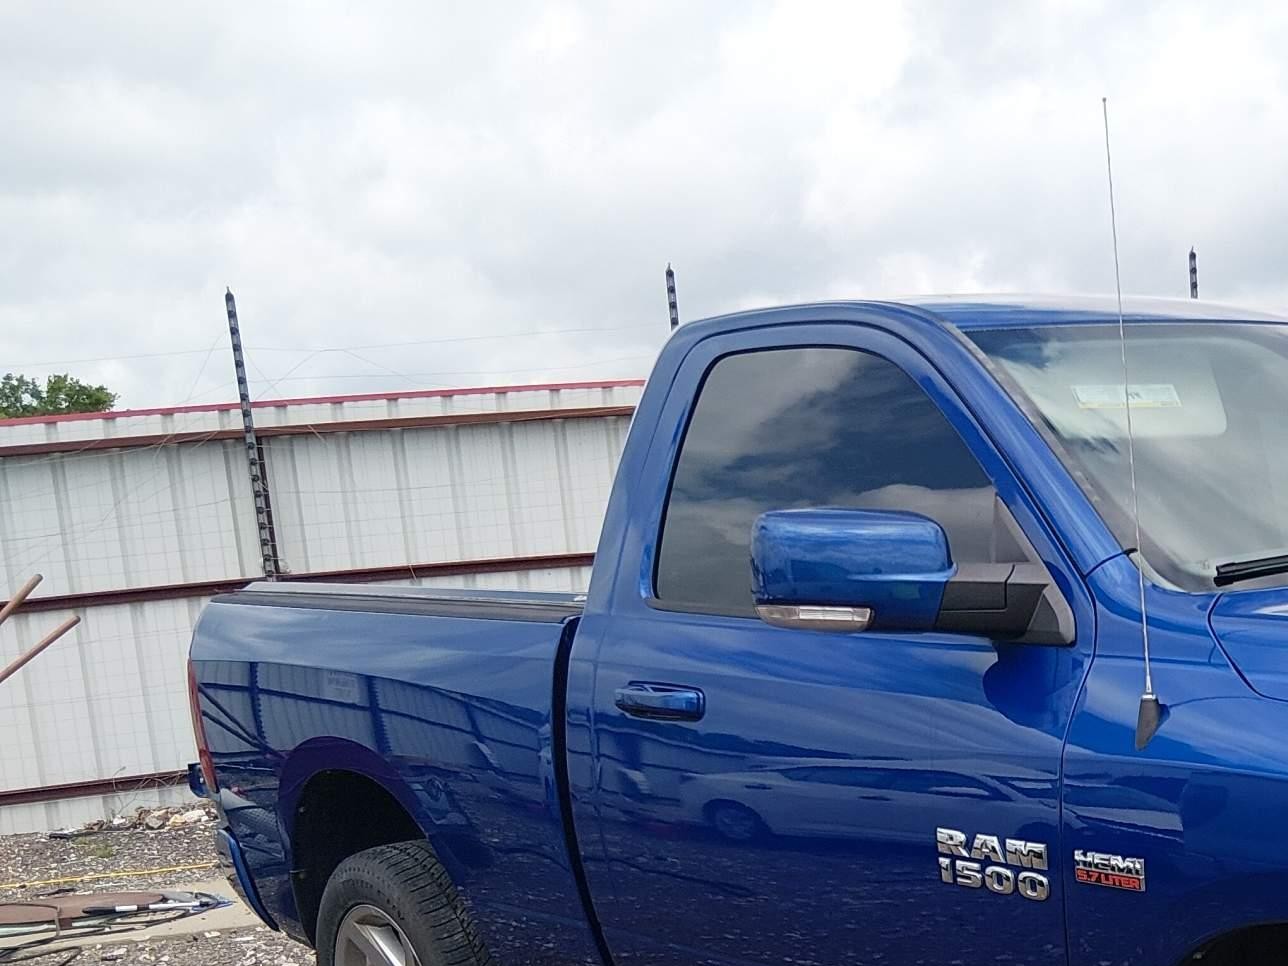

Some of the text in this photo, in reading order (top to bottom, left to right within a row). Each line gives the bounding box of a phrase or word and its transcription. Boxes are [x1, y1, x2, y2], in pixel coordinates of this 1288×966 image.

[937, 827, 1048, 870] RAM
[1074, 850, 1144, 877] HEMI
[938, 858, 1049, 901] 1500
[1077, 869, 1140, 890] 5.7 LITER
